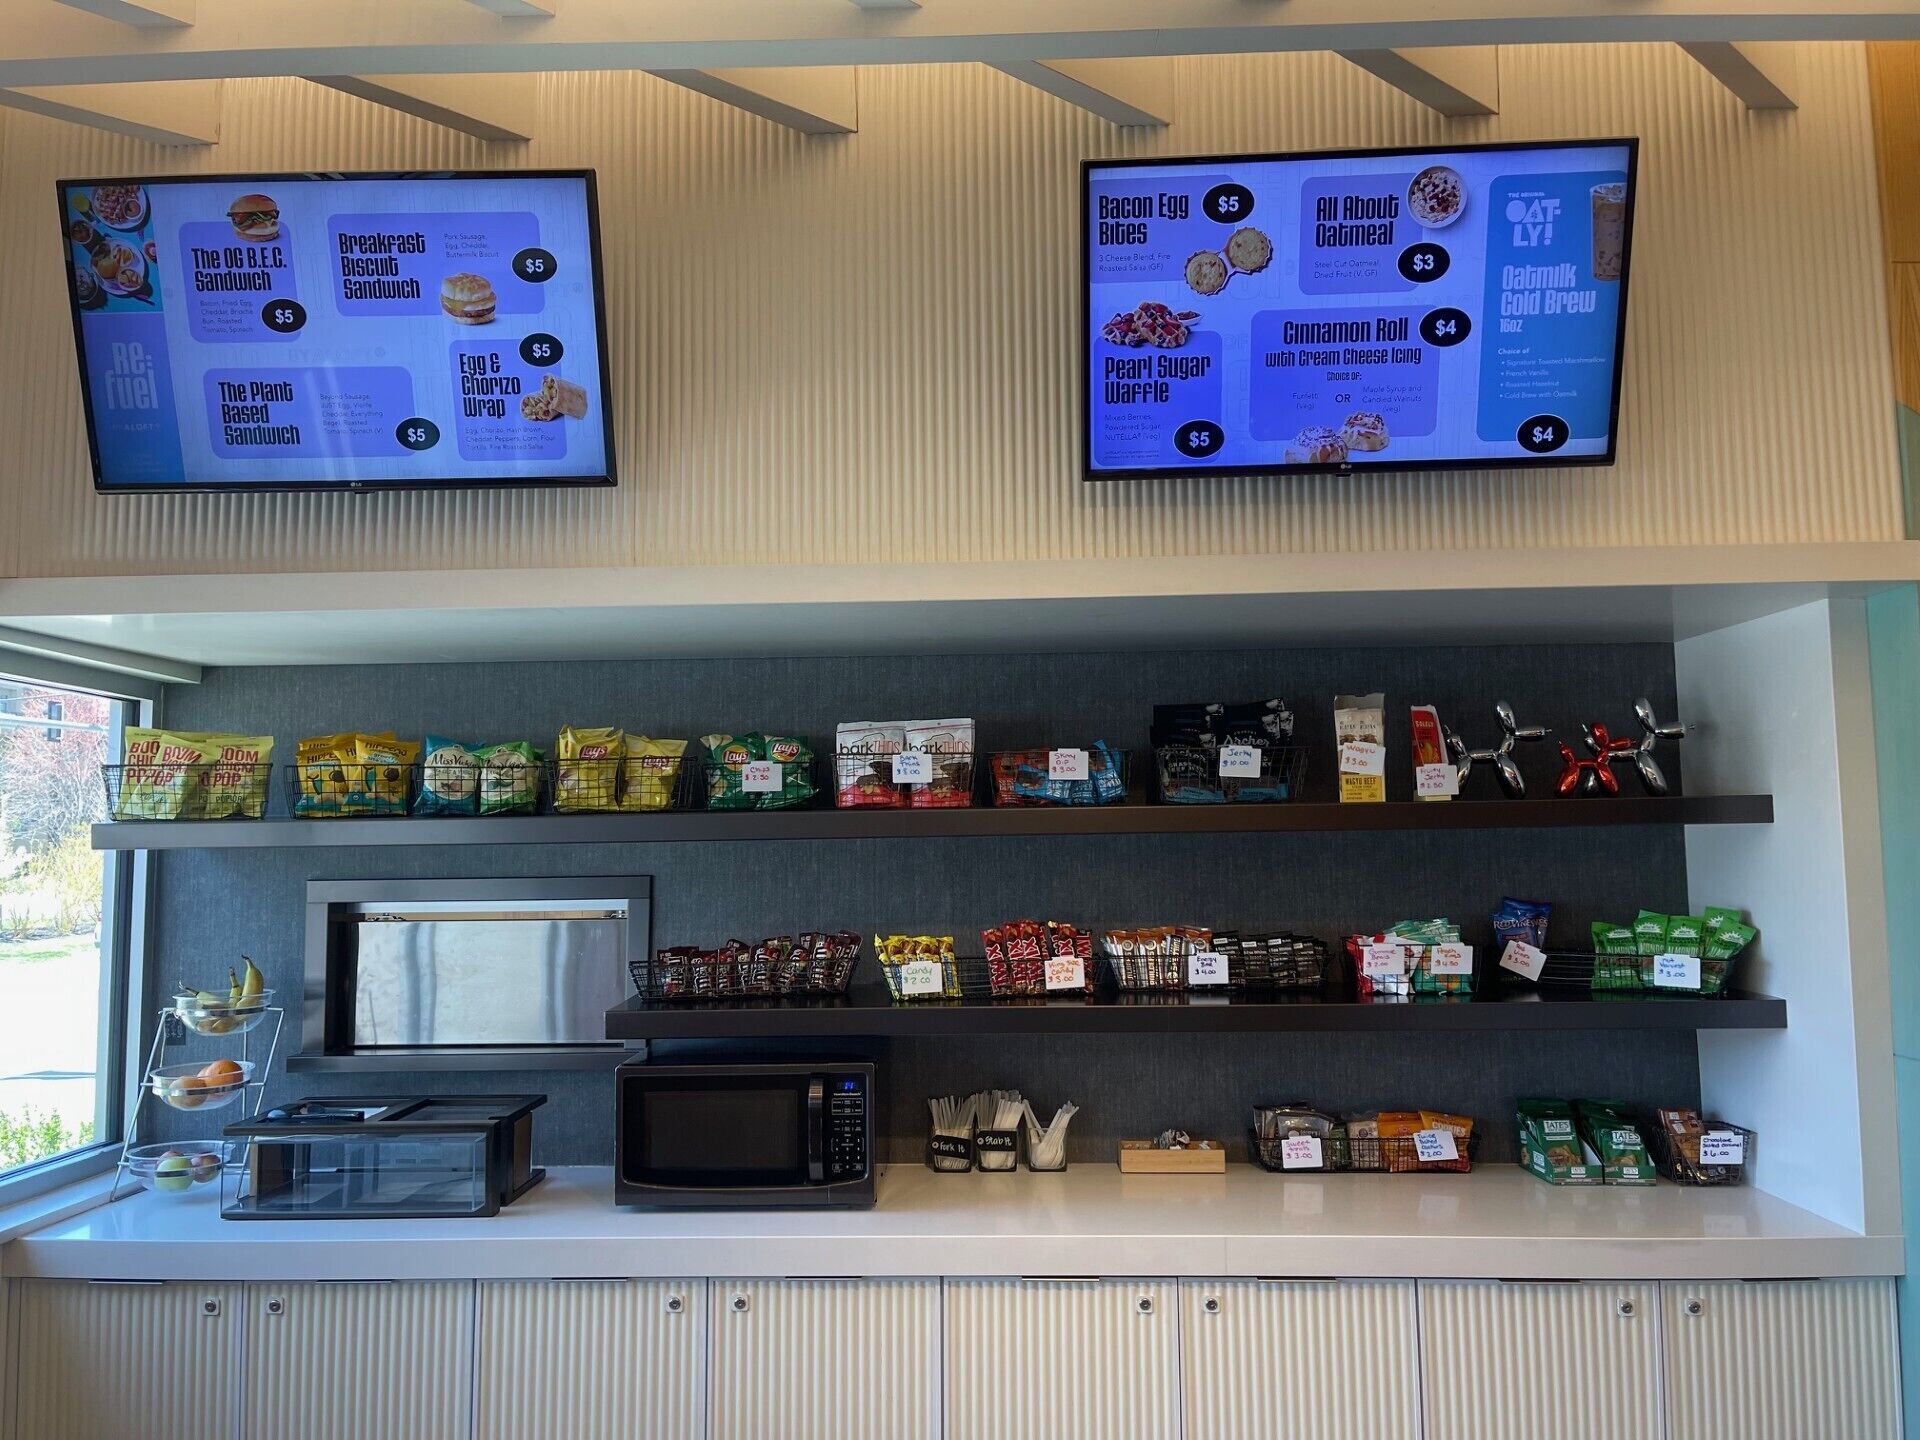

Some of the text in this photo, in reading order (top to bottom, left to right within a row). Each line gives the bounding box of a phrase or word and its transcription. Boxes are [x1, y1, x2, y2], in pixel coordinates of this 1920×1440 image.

[1099, 193, 1189, 220] Bacon Egg
[1218, 196, 1239, 214] $5
[1317, 193, 1399, 222] All About
[338, 232, 426, 254] Breakfast
[1099, 221, 1147, 246] Bites
[1316, 222, 1394, 248] Oatmeal
[1513, 223, 1552, 246] LY!
[192, 247, 287, 268] The OG B.E.C.
[341, 256, 399, 276] Biscuit
[526, 258, 544, 273] $5
[1413, 254, 1434, 272] $3
[195, 270, 271, 292] Sandwich
[1503, 264, 1576, 289] Oatmilk
[344, 278, 421, 300] Sandwich
[1501, 290, 1596, 316] Cold Brew
[274, 309, 294, 324] $5
[1284, 317, 1408, 344] Cinnamon Roll
[1435, 319, 1456, 336] $4
[533, 344, 550, 358] $5
[1266, 347, 1422, 367] with Cream Cheese Icing
[459, 353, 501, 375] Egg &
[1104, 354, 1211, 380] Pearl Sugar
[461, 375, 521, 395] Chorizo
[1326, 372, 1350, 381] Choice
[104, 369, 158, 410] fuel
[218, 382, 293, 402] The Plant
[1104, 380, 1169, 405] Waffle
[1335, 394, 1351, 403] OR
[222, 404, 269, 424] Based
[463, 398, 506, 418] Wrap
[224, 425, 300, 445] Sandwich
[407, 428, 425, 442] $5
[1189, 431, 1210, 448] $5
[1532, 426, 1553, 444] $4
[130, 741, 160, 754] BOO
[940, 1141, 955, 1151] Fork
[985, 1136, 1004, 1145] Stab
